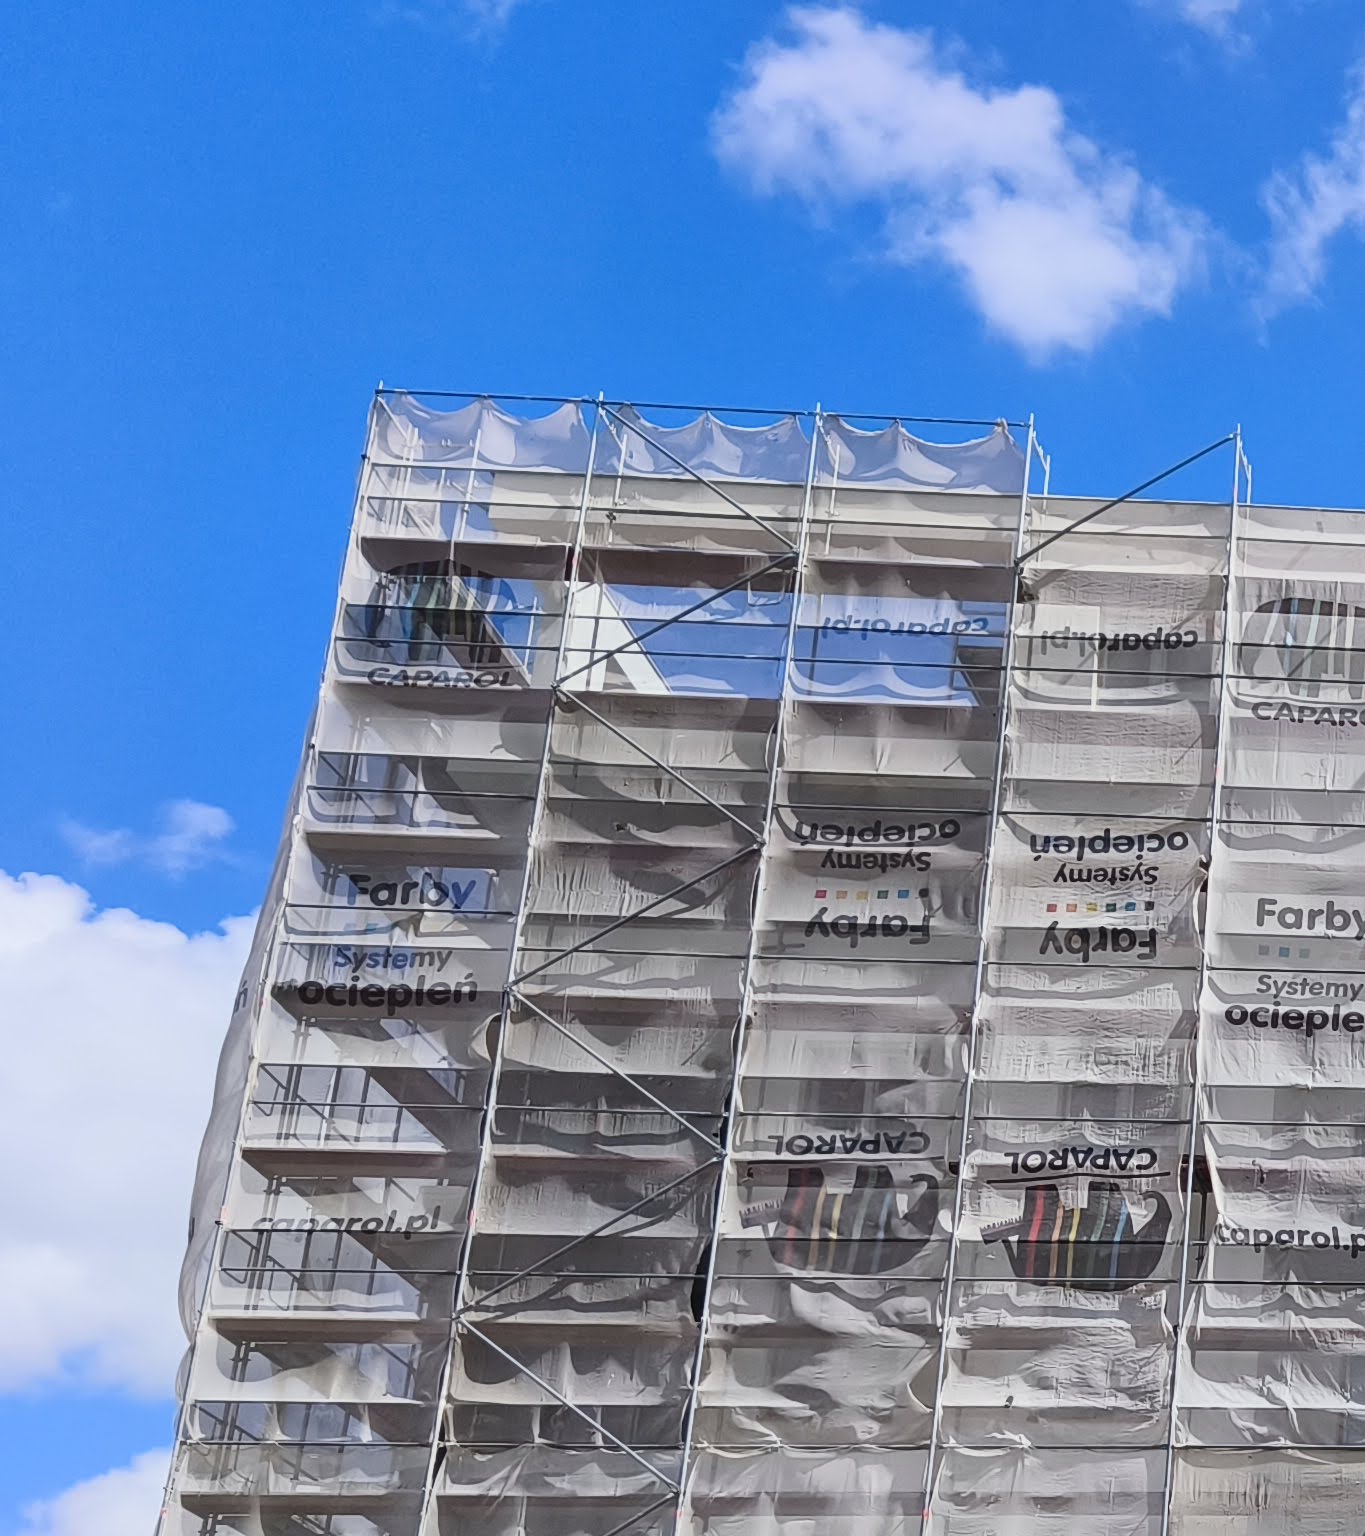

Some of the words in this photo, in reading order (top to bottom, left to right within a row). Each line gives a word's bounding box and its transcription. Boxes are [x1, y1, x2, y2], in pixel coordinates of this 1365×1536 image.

[367, 666, 512, 690] CAPAROL
[796, 816, 962, 846] ociepleń
[1029, 830, 1189, 862] ociepleń
[821, 851, 931, 872] Systemy
[1053, 862, 1158, 885] Systemy
[347, 872, 476, 918] Farby
[805, 904, 931, 946] Farby
[1039, 921, 1158, 962] Farby
[333, 946, 453, 974] Systemy
[298, 973, 478, 1017] ociepleń
[1257, 974, 1364, 1002] Systemy
[767, 1133, 931, 1156] CAPAROL
[1008, 1147, 1159, 1173] CAPAROL
